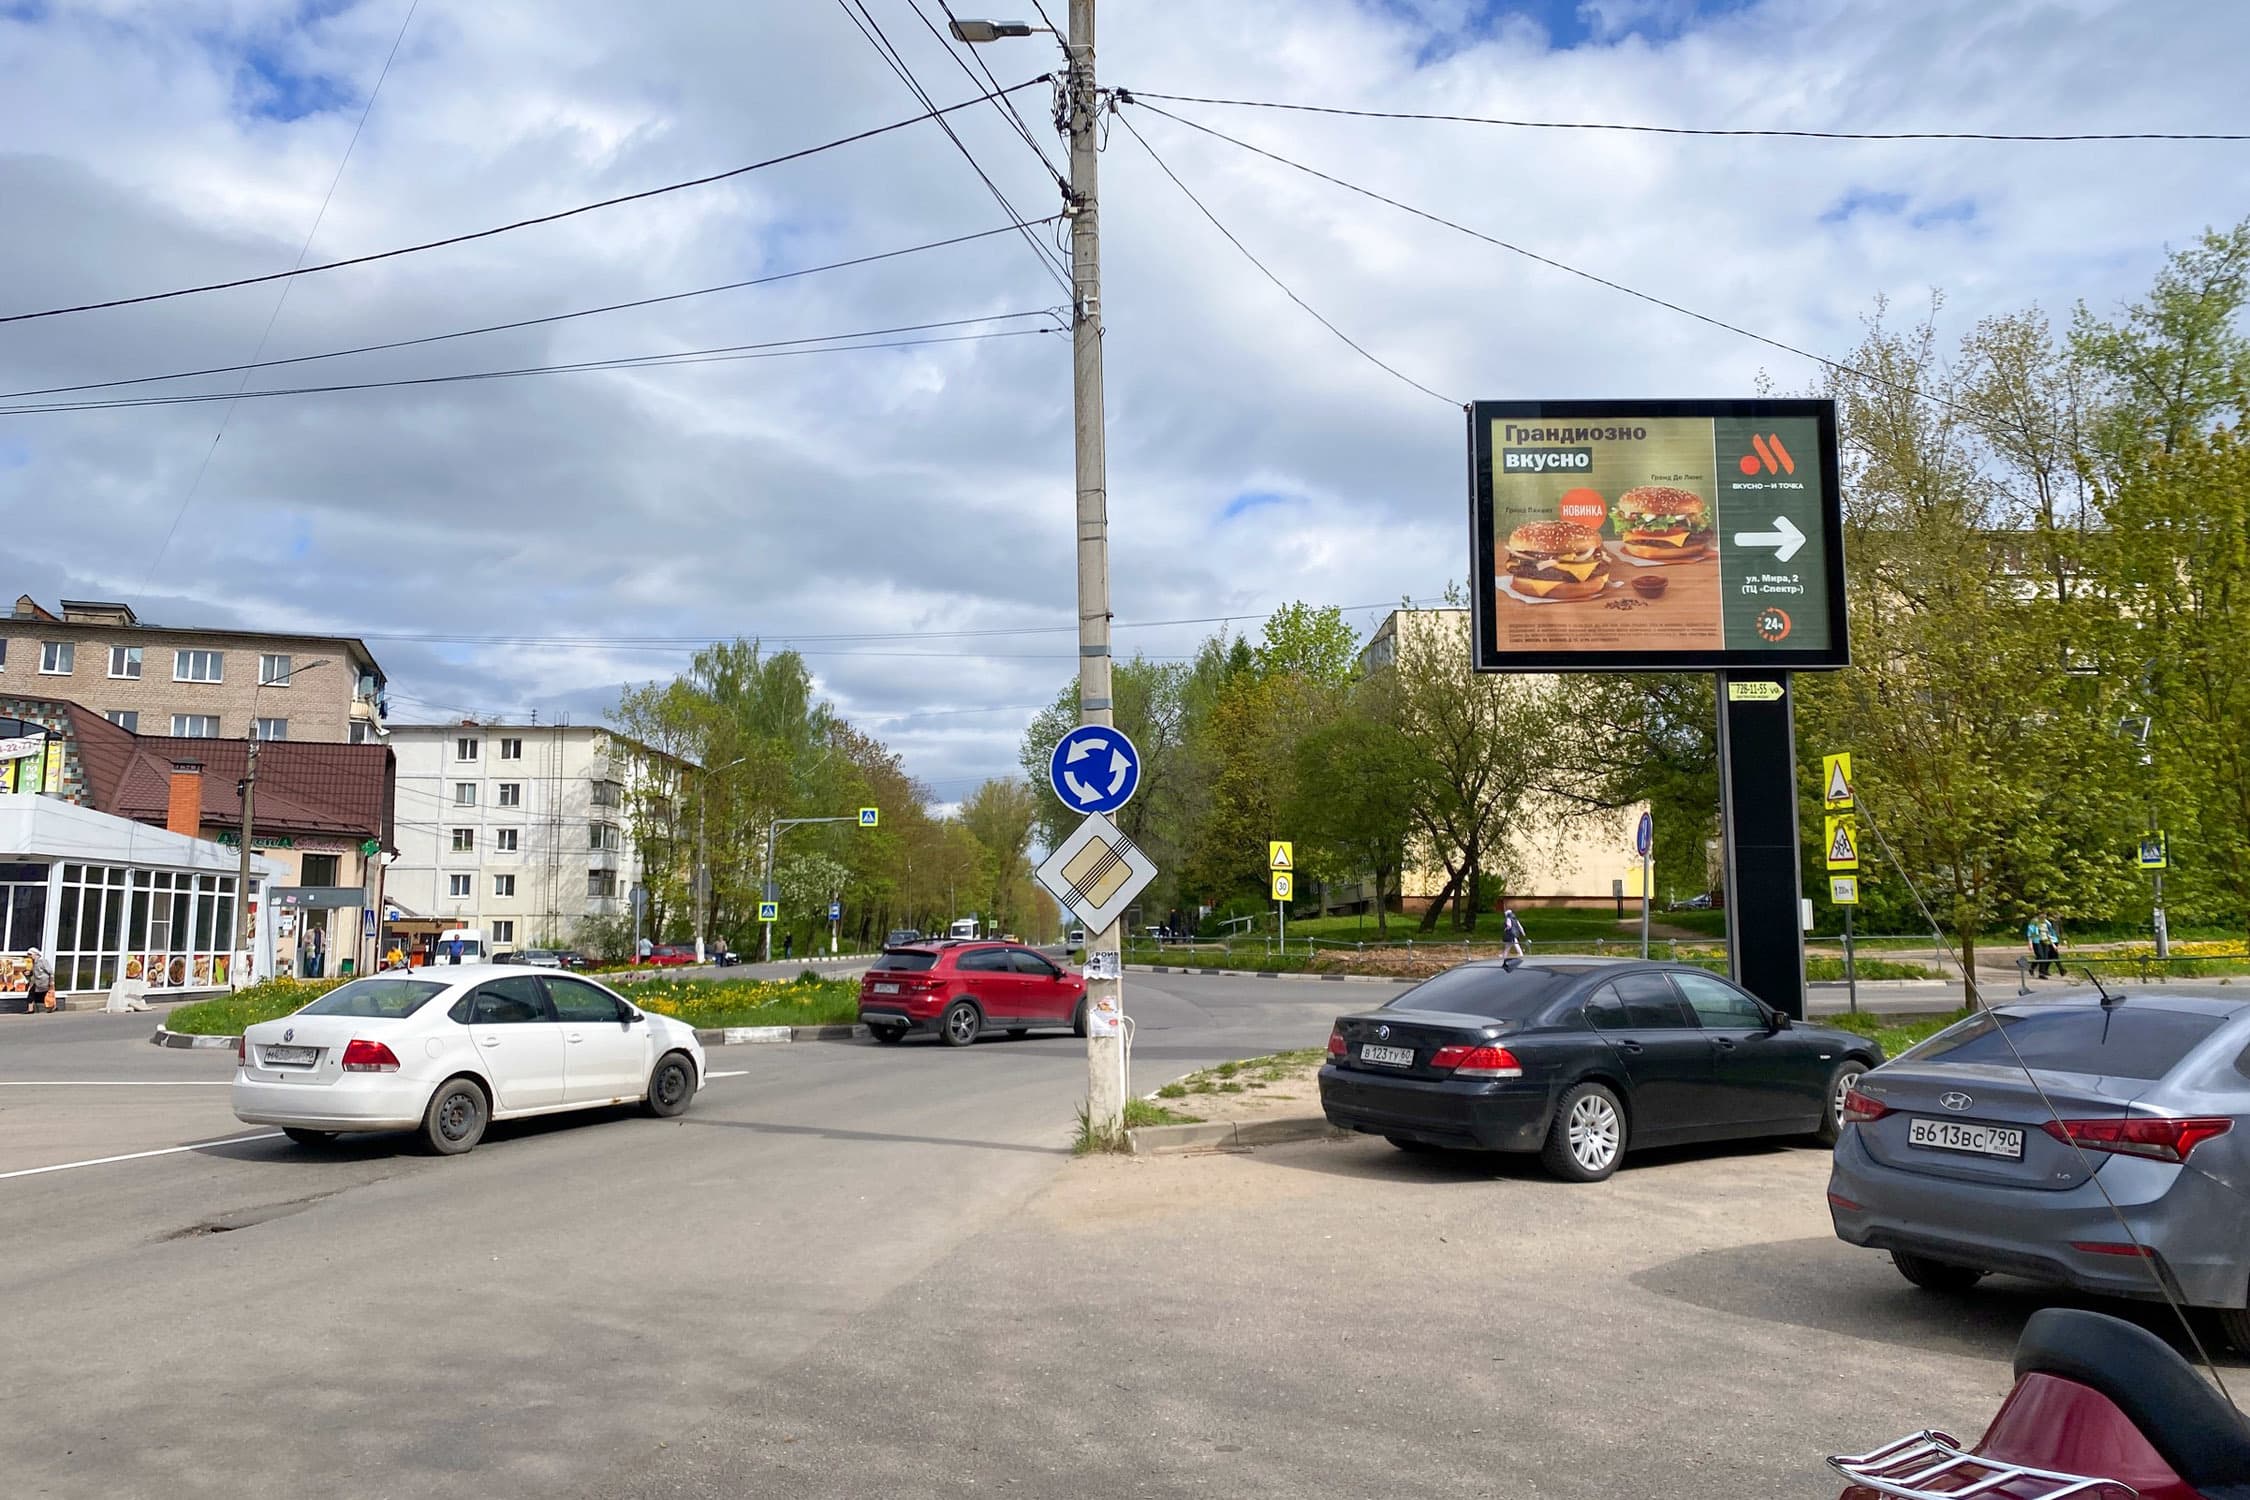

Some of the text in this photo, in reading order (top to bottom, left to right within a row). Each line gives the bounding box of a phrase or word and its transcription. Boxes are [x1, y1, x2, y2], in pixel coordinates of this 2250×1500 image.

[1505, 424, 1647, 445] Грандиозно
[1506, 453, 1590, 472] вкусно
[1562, 503, 1603, 517] НОВИНКА
[1746, 574, 1799, 584] ул. Мира, 2
[1742, 585, 1758, 595] (ТЦ
[1278, 881, 1287, 891] 30
[1988, 1129, 2017, 1147] 790
